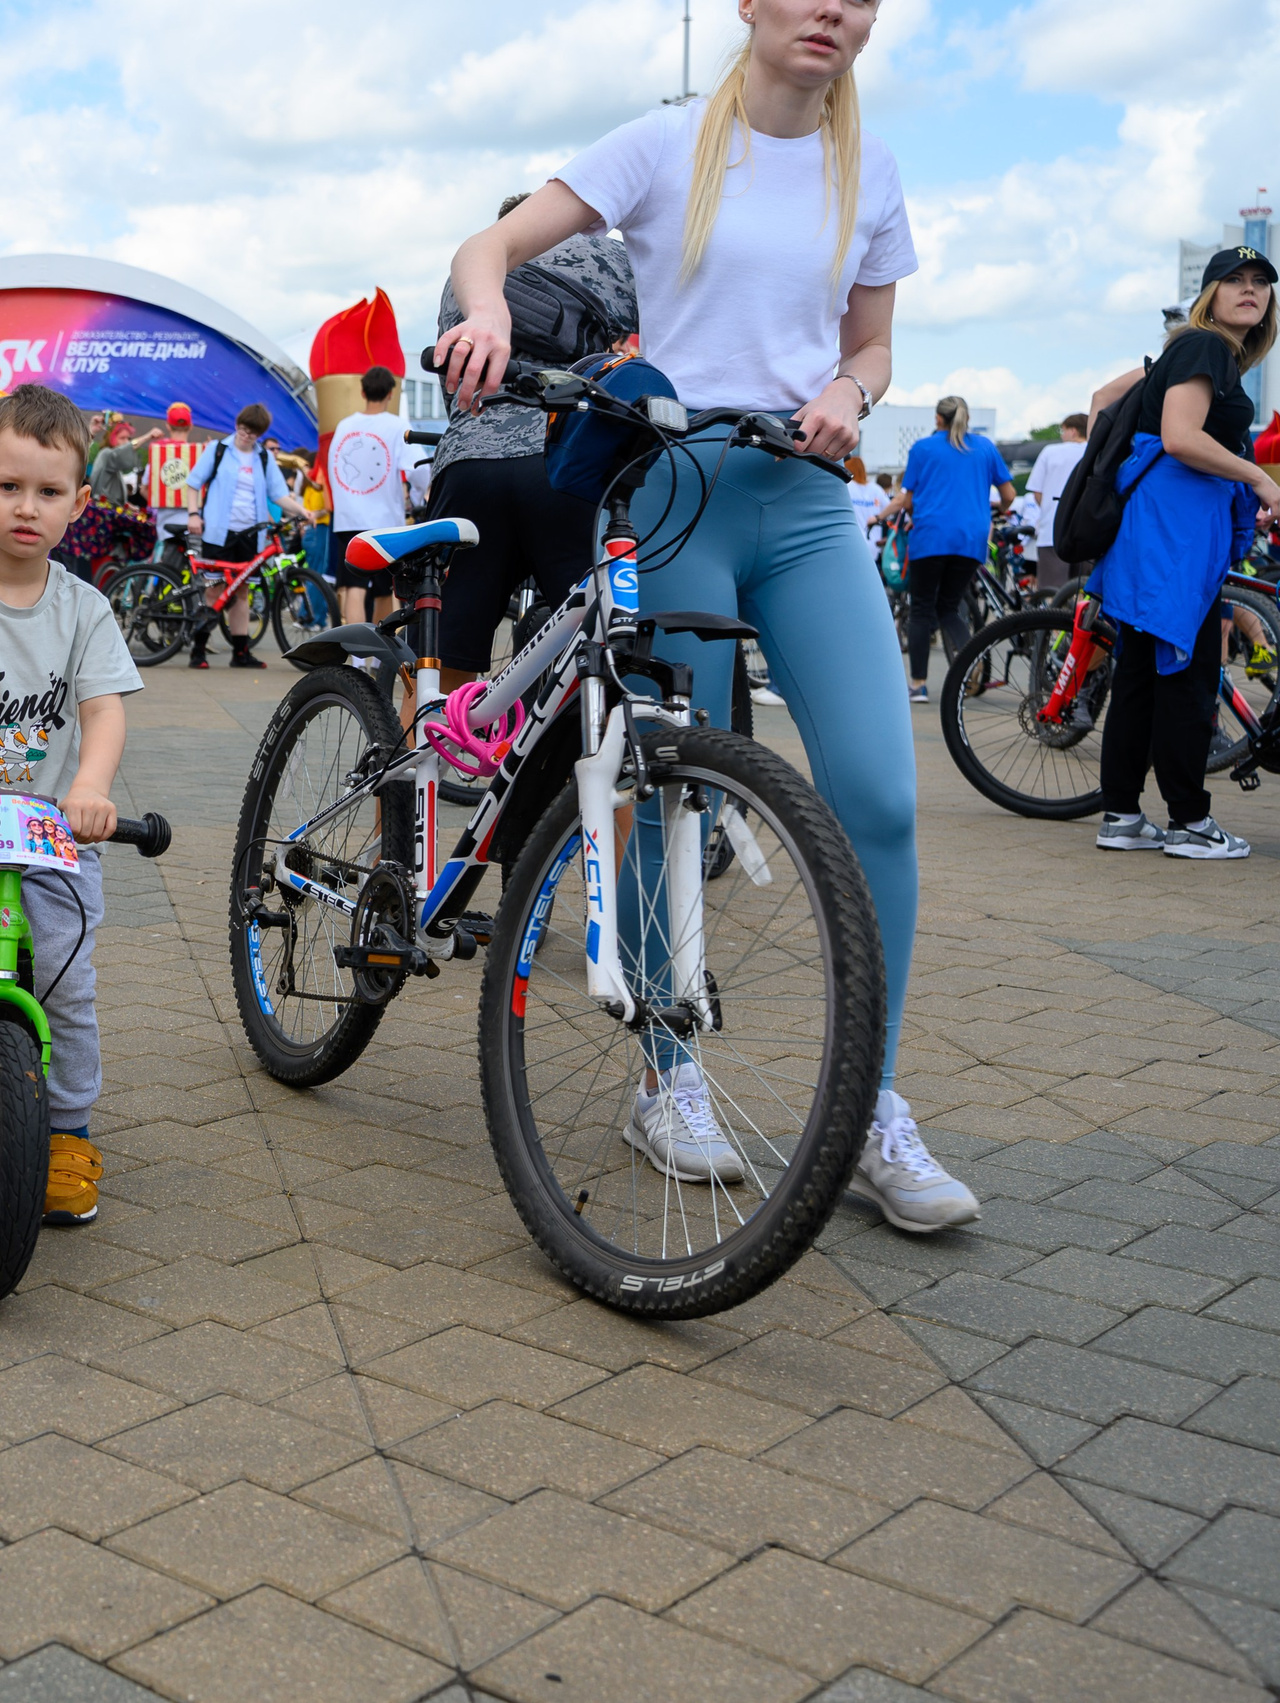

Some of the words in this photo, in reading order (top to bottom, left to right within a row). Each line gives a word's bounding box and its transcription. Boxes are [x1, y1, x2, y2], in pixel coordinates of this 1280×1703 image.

[61, 357, 111, 373] КЛУБ
[65, 340, 208, 361] ВЕЛОСИПЕДНЫЙ
[253, 701, 292, 781] STELS
[584, 827, 604, 913] XCT
[309, 884, 354, 919] STELS
[520, 860, 570, 965] STELS
[249, 924, 268, 998] STELS
[620, 1258, 726, 1293] STELS
